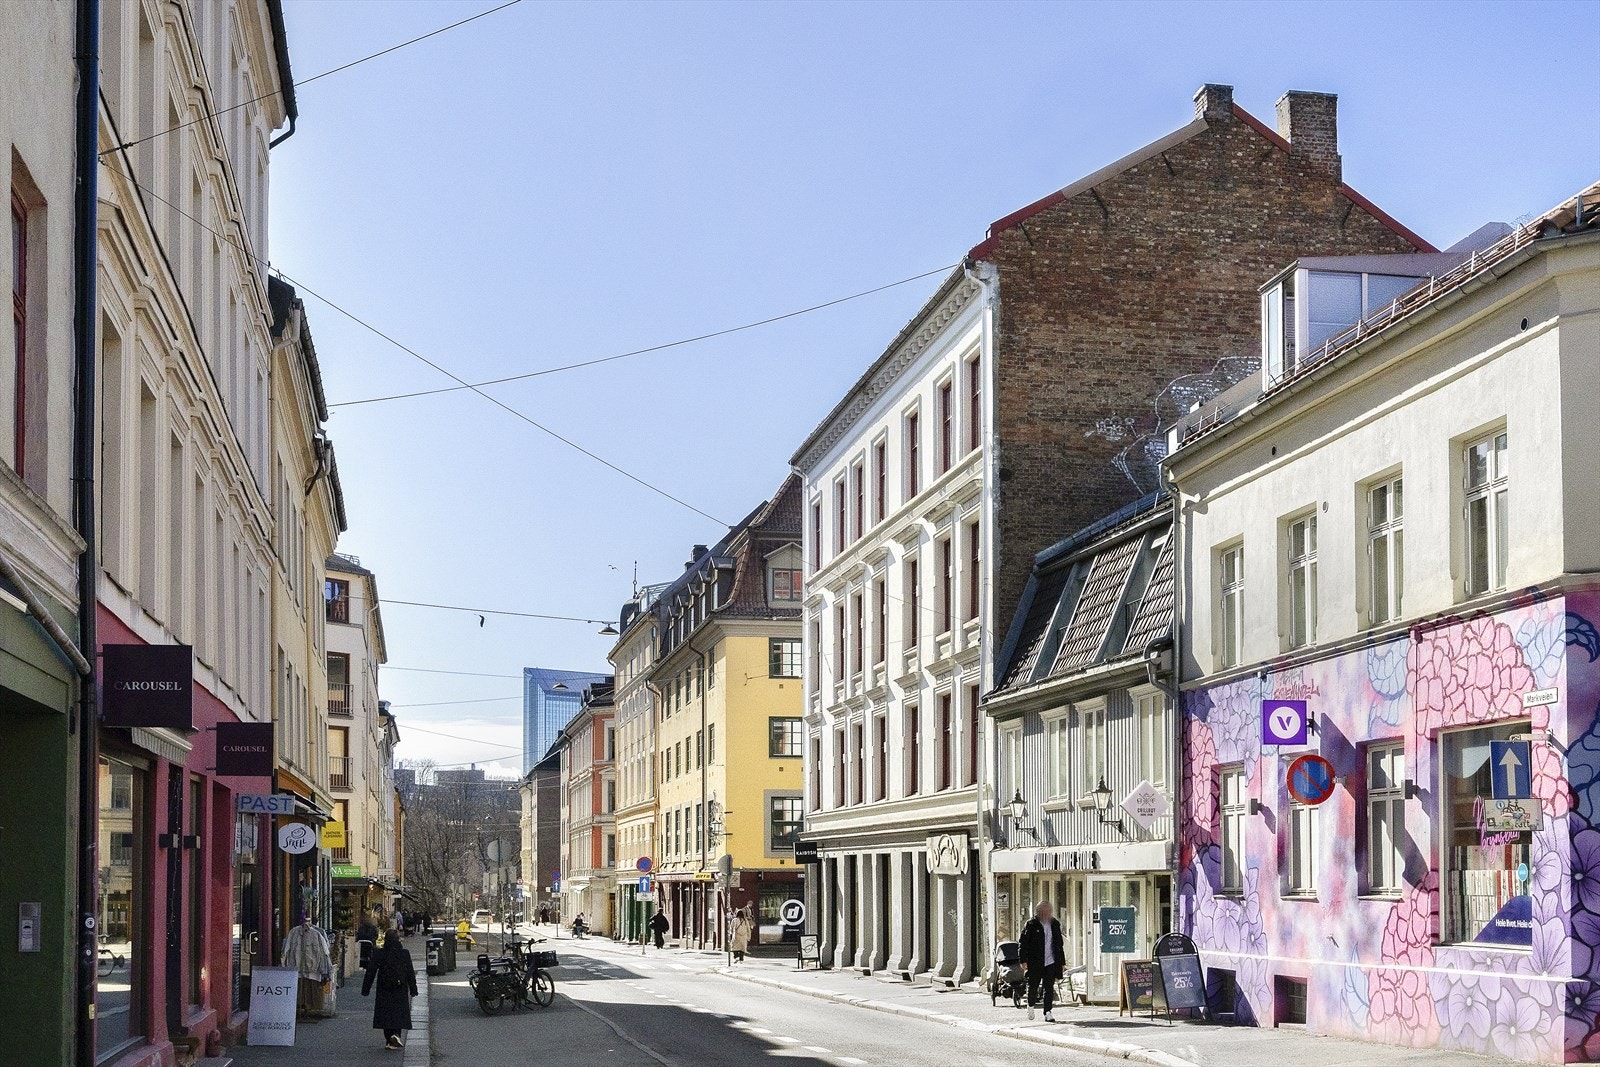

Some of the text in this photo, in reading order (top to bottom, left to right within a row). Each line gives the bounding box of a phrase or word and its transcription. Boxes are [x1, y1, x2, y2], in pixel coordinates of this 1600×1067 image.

[114, 681, 182, 690] CAROUSEL
[1526, 693, 1554, 703] Markveien
[240, 796, 291, 811] PAST
[1109, 924, 1126, 935] 25%
[1173, 977, 1193, 989] 25%
[256, 986, 291, 996] PAST
